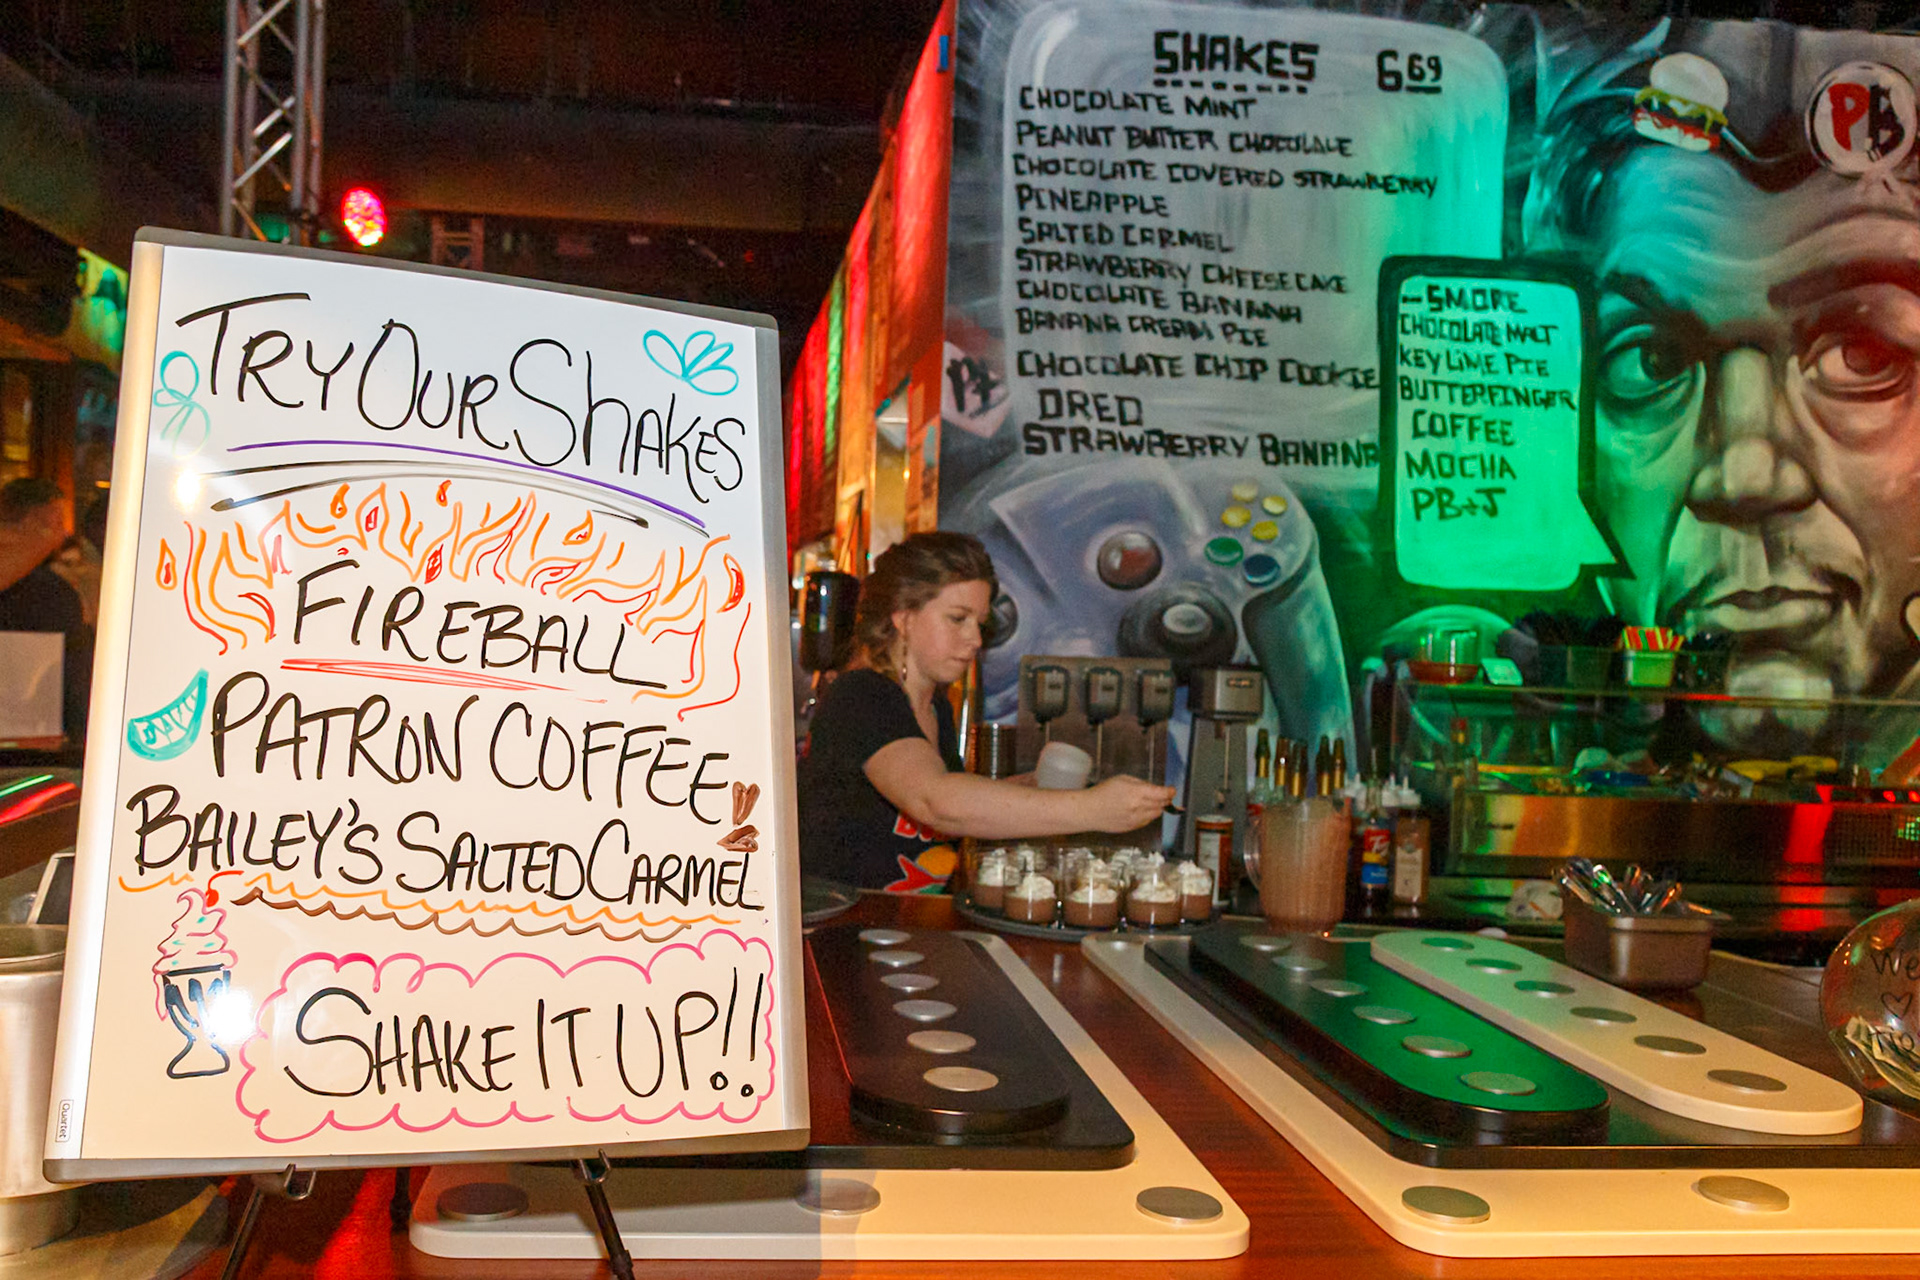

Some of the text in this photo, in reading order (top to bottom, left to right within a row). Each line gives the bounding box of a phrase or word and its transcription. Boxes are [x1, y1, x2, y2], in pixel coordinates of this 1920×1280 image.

[1153, 31, 1320, 82] SHAKES
[1019, 85, 1257, 120] CHOCOLATE MINT
[1015, 120, 1115, 148] PEANUT
[1124, 125, 1219, 151] BUTTER
[1012, 153, 1157, 181] CHOCOLATE
[1167, 161, 1284, 188] COVERED
[1015, 183, 1170, 218] PINEAPPLE
[1018, 217, 1115, 245] SALTED
[1015, 248, 1191, 289] STRAWBERRY
[1016, 279, 1170, 309] CHOCOLATE
[1015, 307, 1269, 348] BANANA CREAM PIE
[1400, 313, 1502, 347] CHOCOLATE
[176, 292, 354, 413] TRY
[357, 317, 509, 451] OUR
[1017, 350, 1184, 378] CHOCOLATE
[1194, 352, 1269, 382] CHIP
[1400, 344, 1442, 375] KEY
[1504, 352, 1550, 377] PIE
[1022, 421, 1380, 468] STRAWBERRY BANANA
[1412, 409, 1516, 446] COFFEE
[1405, 448, 1518, 481] MOCHA
[293, 559, 668, 690] FIREBALL
[210, 670, 731, 826] PATRON COFFEE
[395, 811, 587, 904] SALTED
[587, 819, 766, 911] CARMEL
[284, 986, 515, 1098] SHAKE
[535, 998, 592, 1093] IT
[58, 1103, 71, 1138] Quartet
